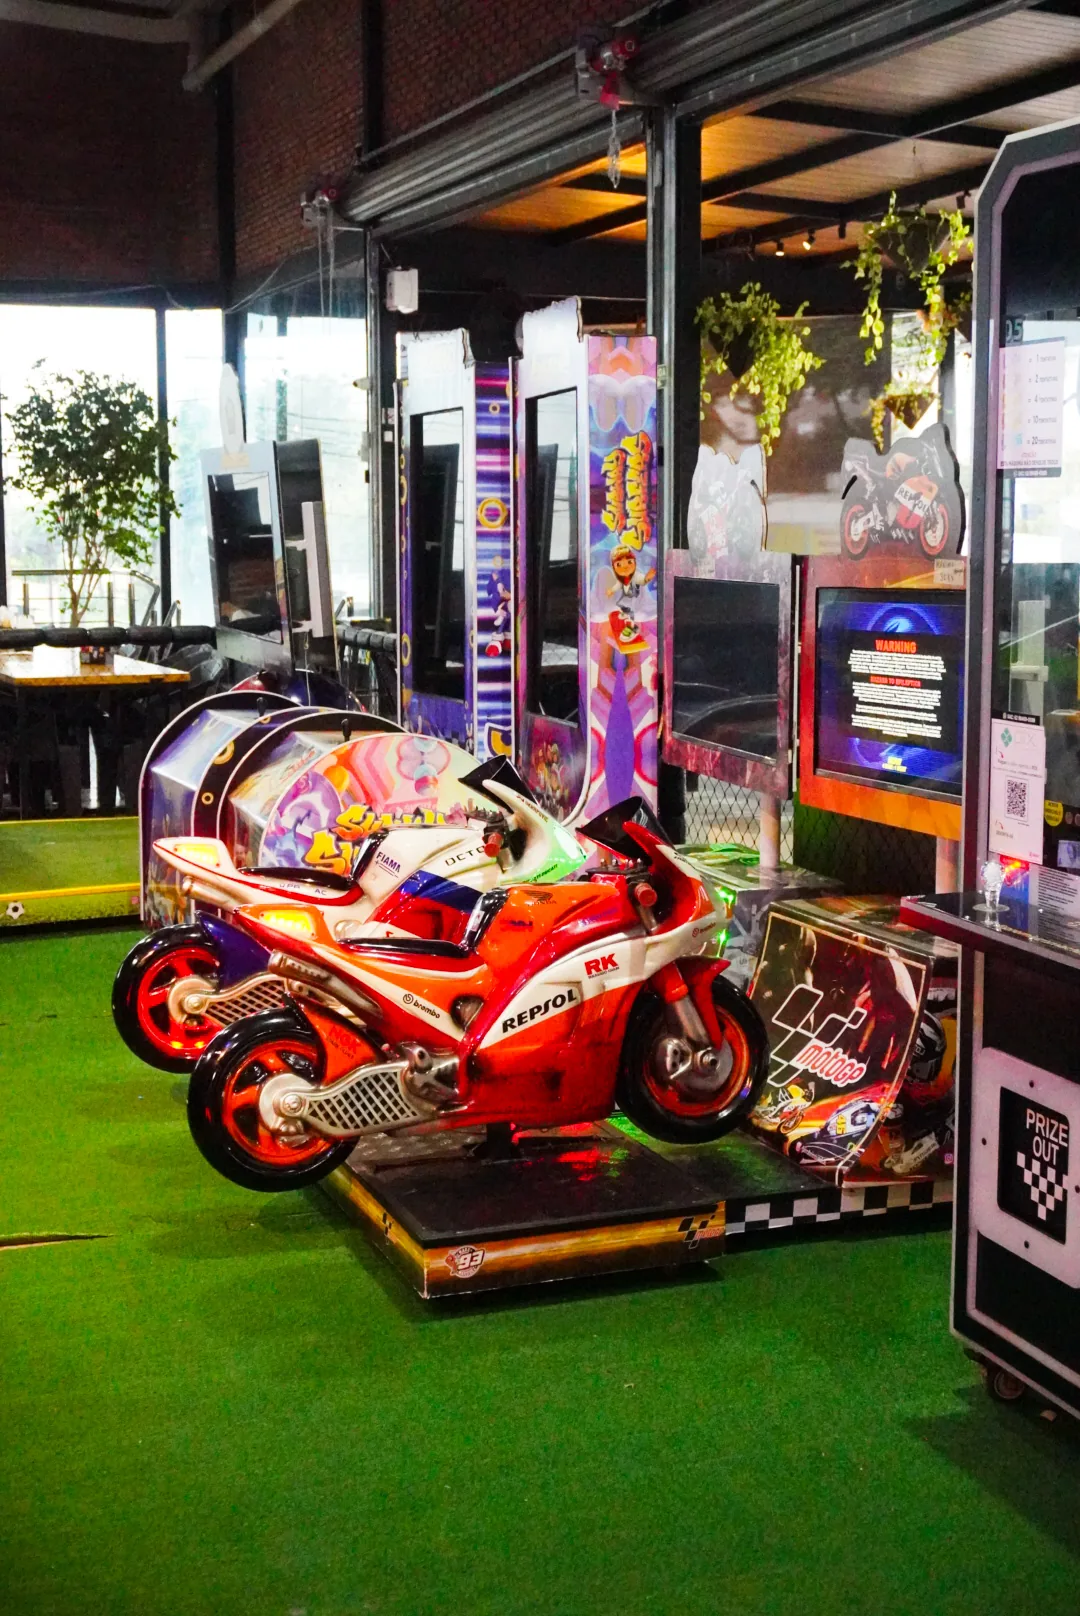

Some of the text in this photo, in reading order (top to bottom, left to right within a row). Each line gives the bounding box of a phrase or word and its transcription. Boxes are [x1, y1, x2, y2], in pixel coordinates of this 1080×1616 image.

[875, 640, 917, 654] WARNING
[584, 953, 618, 976] RK
[413, 1000, 441, 1019] brembo
[502, 989, 577, 1034] REPSOL
[1026, 1108, 1068, 1147] PRIZE
[1032, 1135, 1059, 1166] OUT
[457, 1250, 484, 1270] 93
